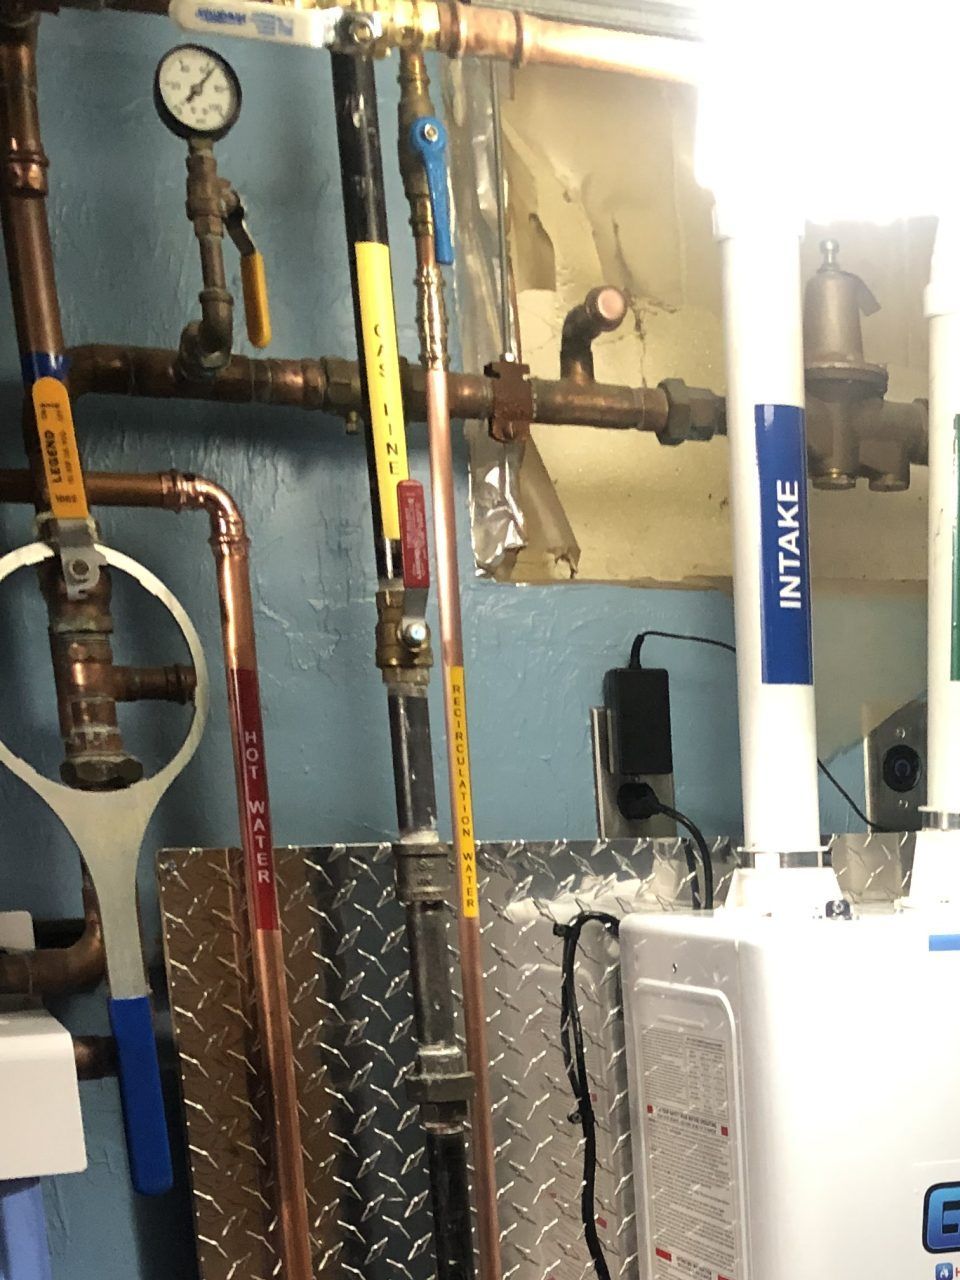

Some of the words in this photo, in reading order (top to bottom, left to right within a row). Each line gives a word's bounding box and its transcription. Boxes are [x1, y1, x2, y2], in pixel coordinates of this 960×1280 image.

[44, 429, 62, 484] LEGEND
[776, 479, 801, 609] INTAKE
[244, 731, 259, 780] HOT
[452, 684, 471, 837] RECIRCULATION
[463, 852, 475, 908] WATER
[249, 800, 271, 883] WATER
